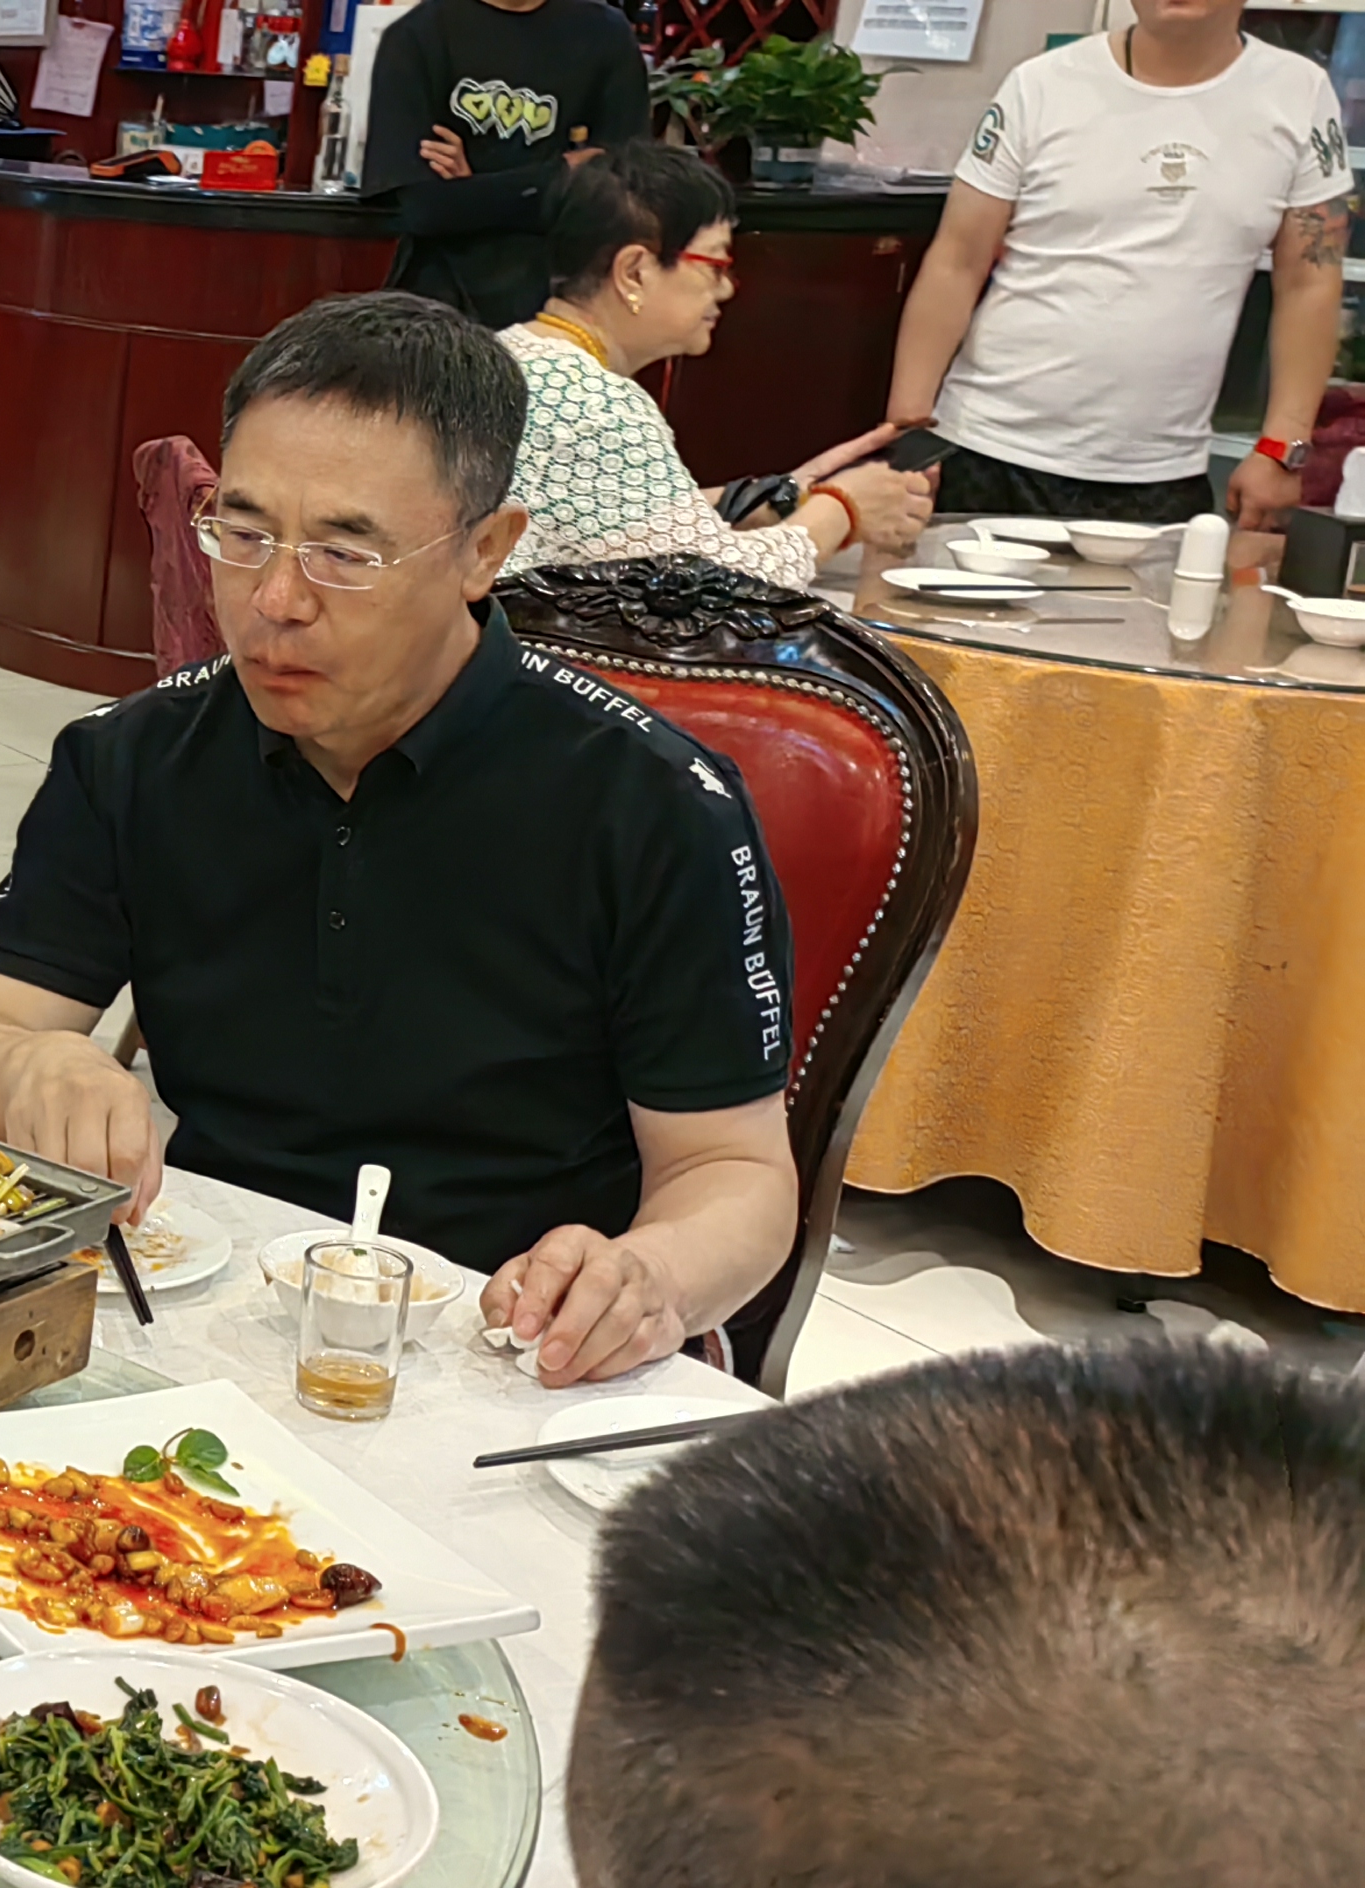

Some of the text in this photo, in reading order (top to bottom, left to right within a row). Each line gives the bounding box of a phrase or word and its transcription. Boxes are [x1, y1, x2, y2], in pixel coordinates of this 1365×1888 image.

[156, 654, 232, 688] BRAU
[553, 668, 655, 733] BÜFFEL
[730, 845, 781, 1061] BRAUN BÜFFEL
